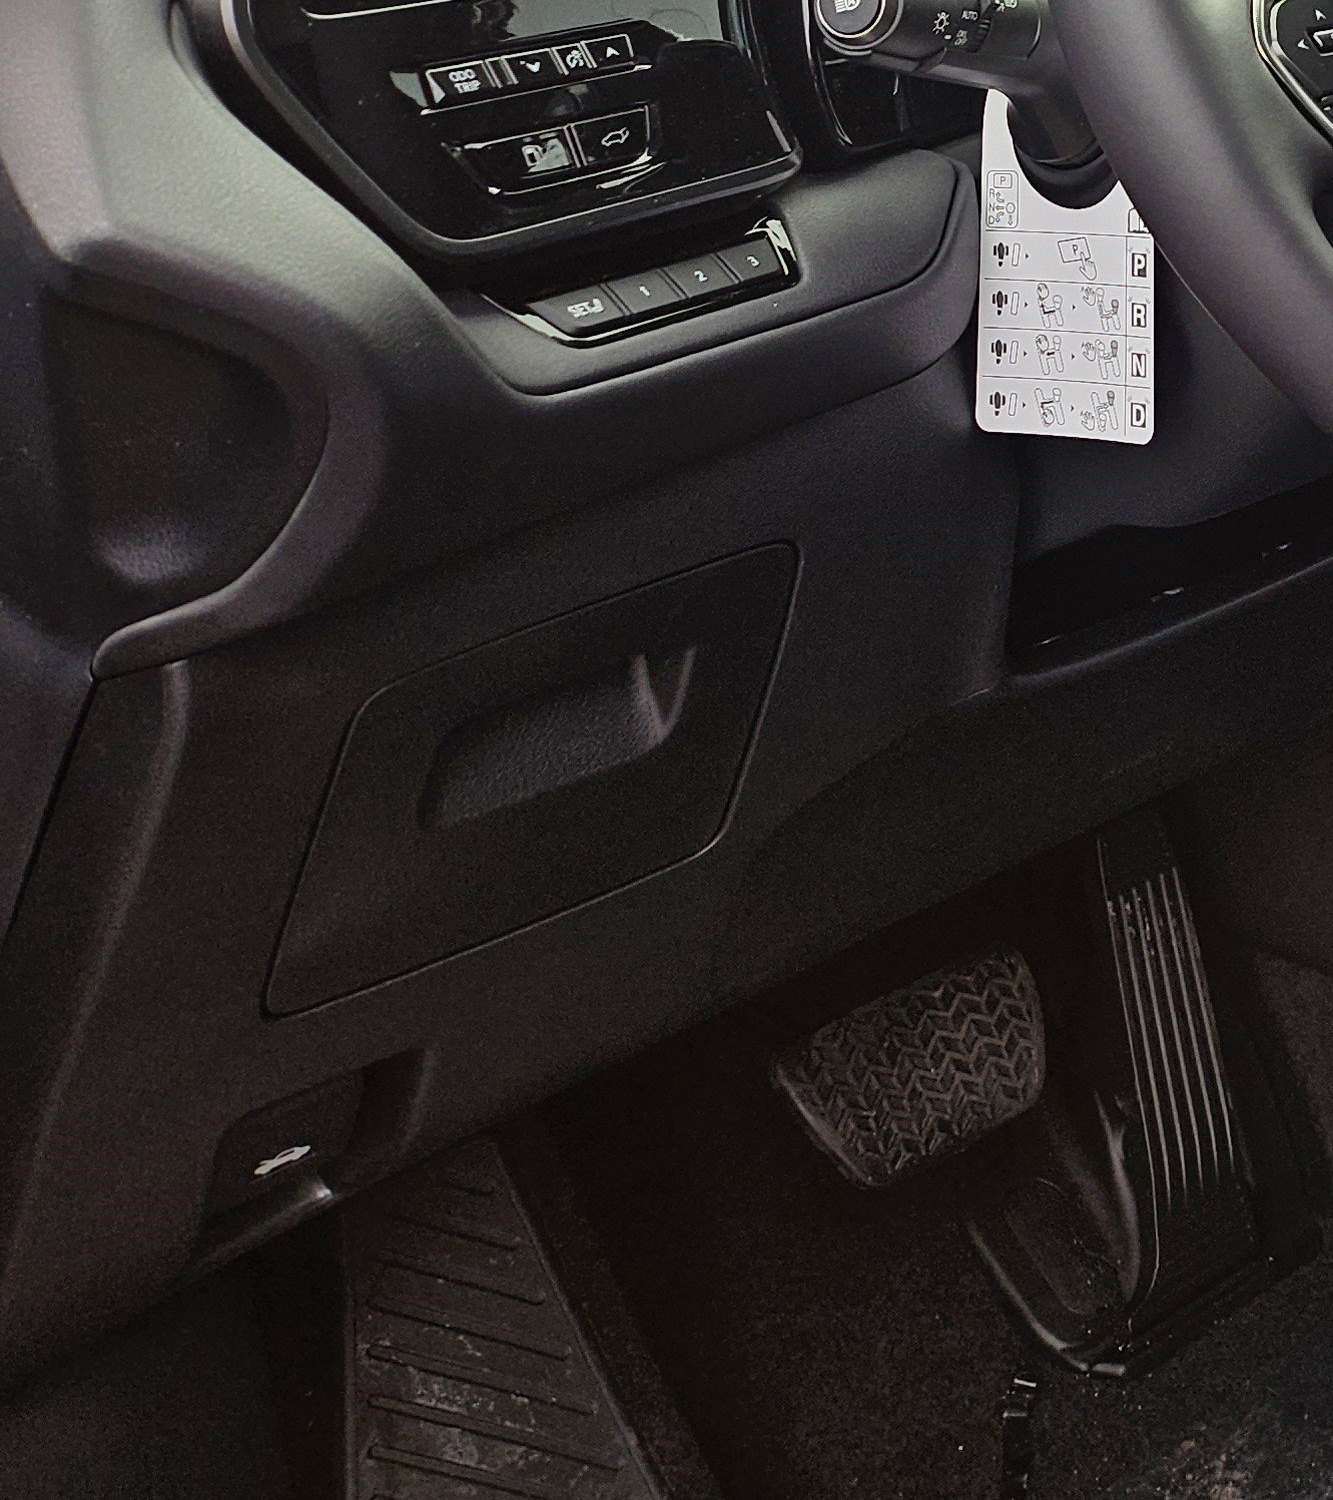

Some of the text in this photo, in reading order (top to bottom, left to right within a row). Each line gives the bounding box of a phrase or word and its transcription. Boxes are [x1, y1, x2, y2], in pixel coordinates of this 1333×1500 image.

[962, 10, 979, 21] AUTO
[639, 285, 650, 297] 1
[693, 270, 707, 282] 2
[746, 255, 760, 267] 3
[1133, 255, 1146, 277] P
[1133, 306, 1147, 327] R
[1132, 356, 1146, 377] N
[1132, 406, 1145, 427] D
